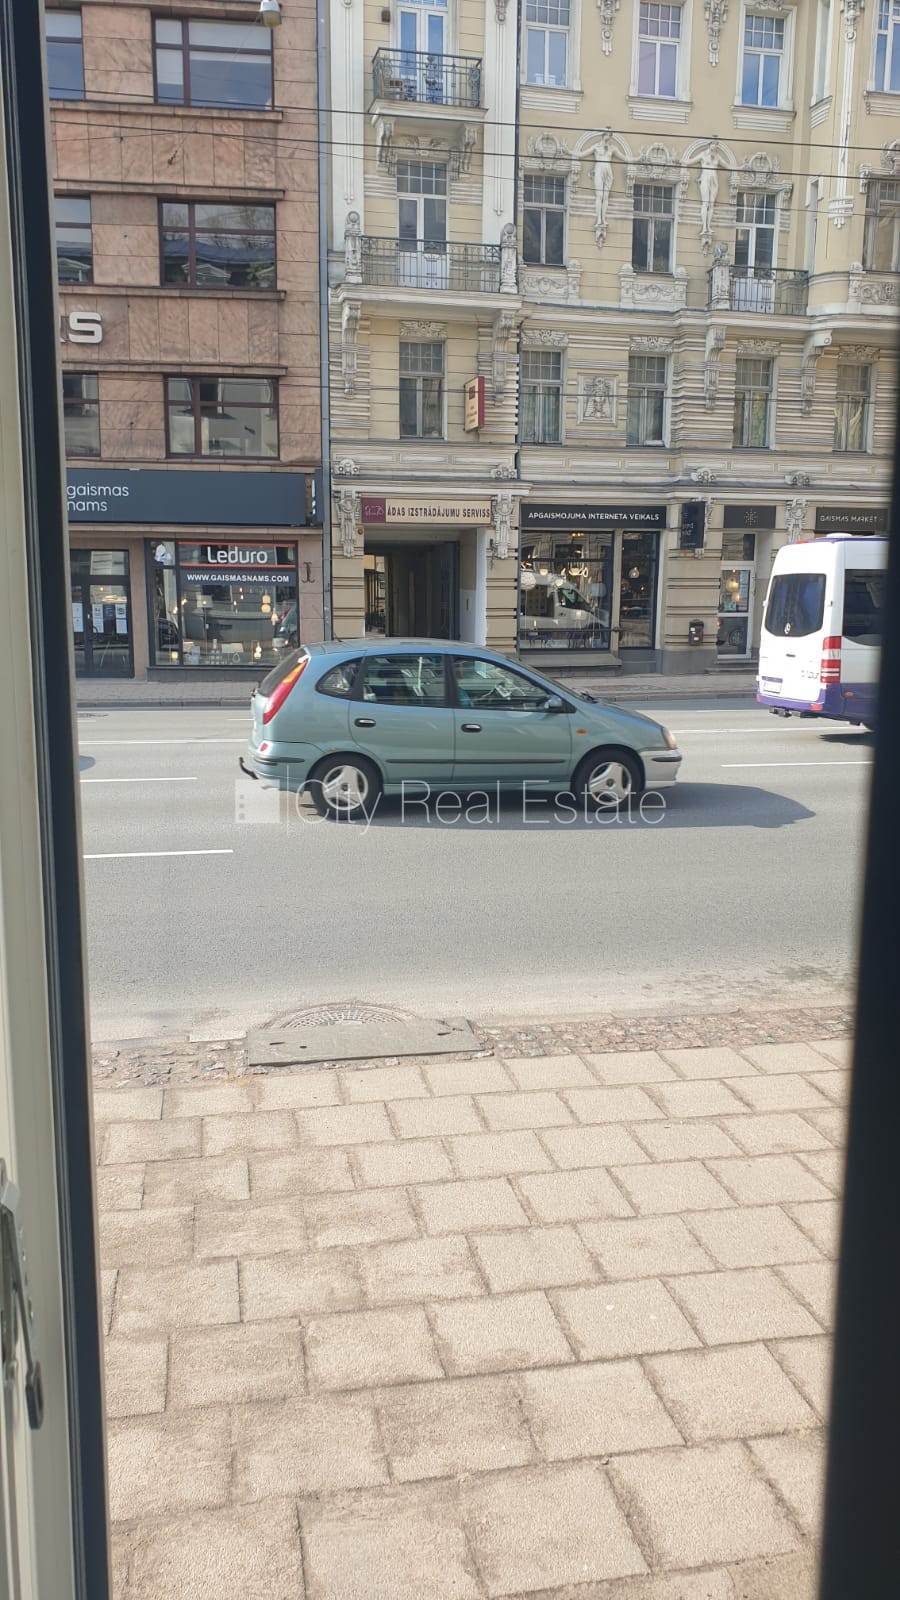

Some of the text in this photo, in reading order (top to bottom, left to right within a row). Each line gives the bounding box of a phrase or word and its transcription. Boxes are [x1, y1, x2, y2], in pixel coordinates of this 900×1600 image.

[59, 312, 102, 343] S
[66, 482, 129, 499] gaismas
[67, 501, 108, 512] nams
[462, 508, 491, 518] SERVISS
[528, 511, 660, 521] APGAISMOJUMA INTERNETA VEIKALS
[850, 515, 878, 523] MARKET
[206, 546, 268, 564] Leduro
[186, 573, 290, 583] WWW.GAISMASNAMS.COM
